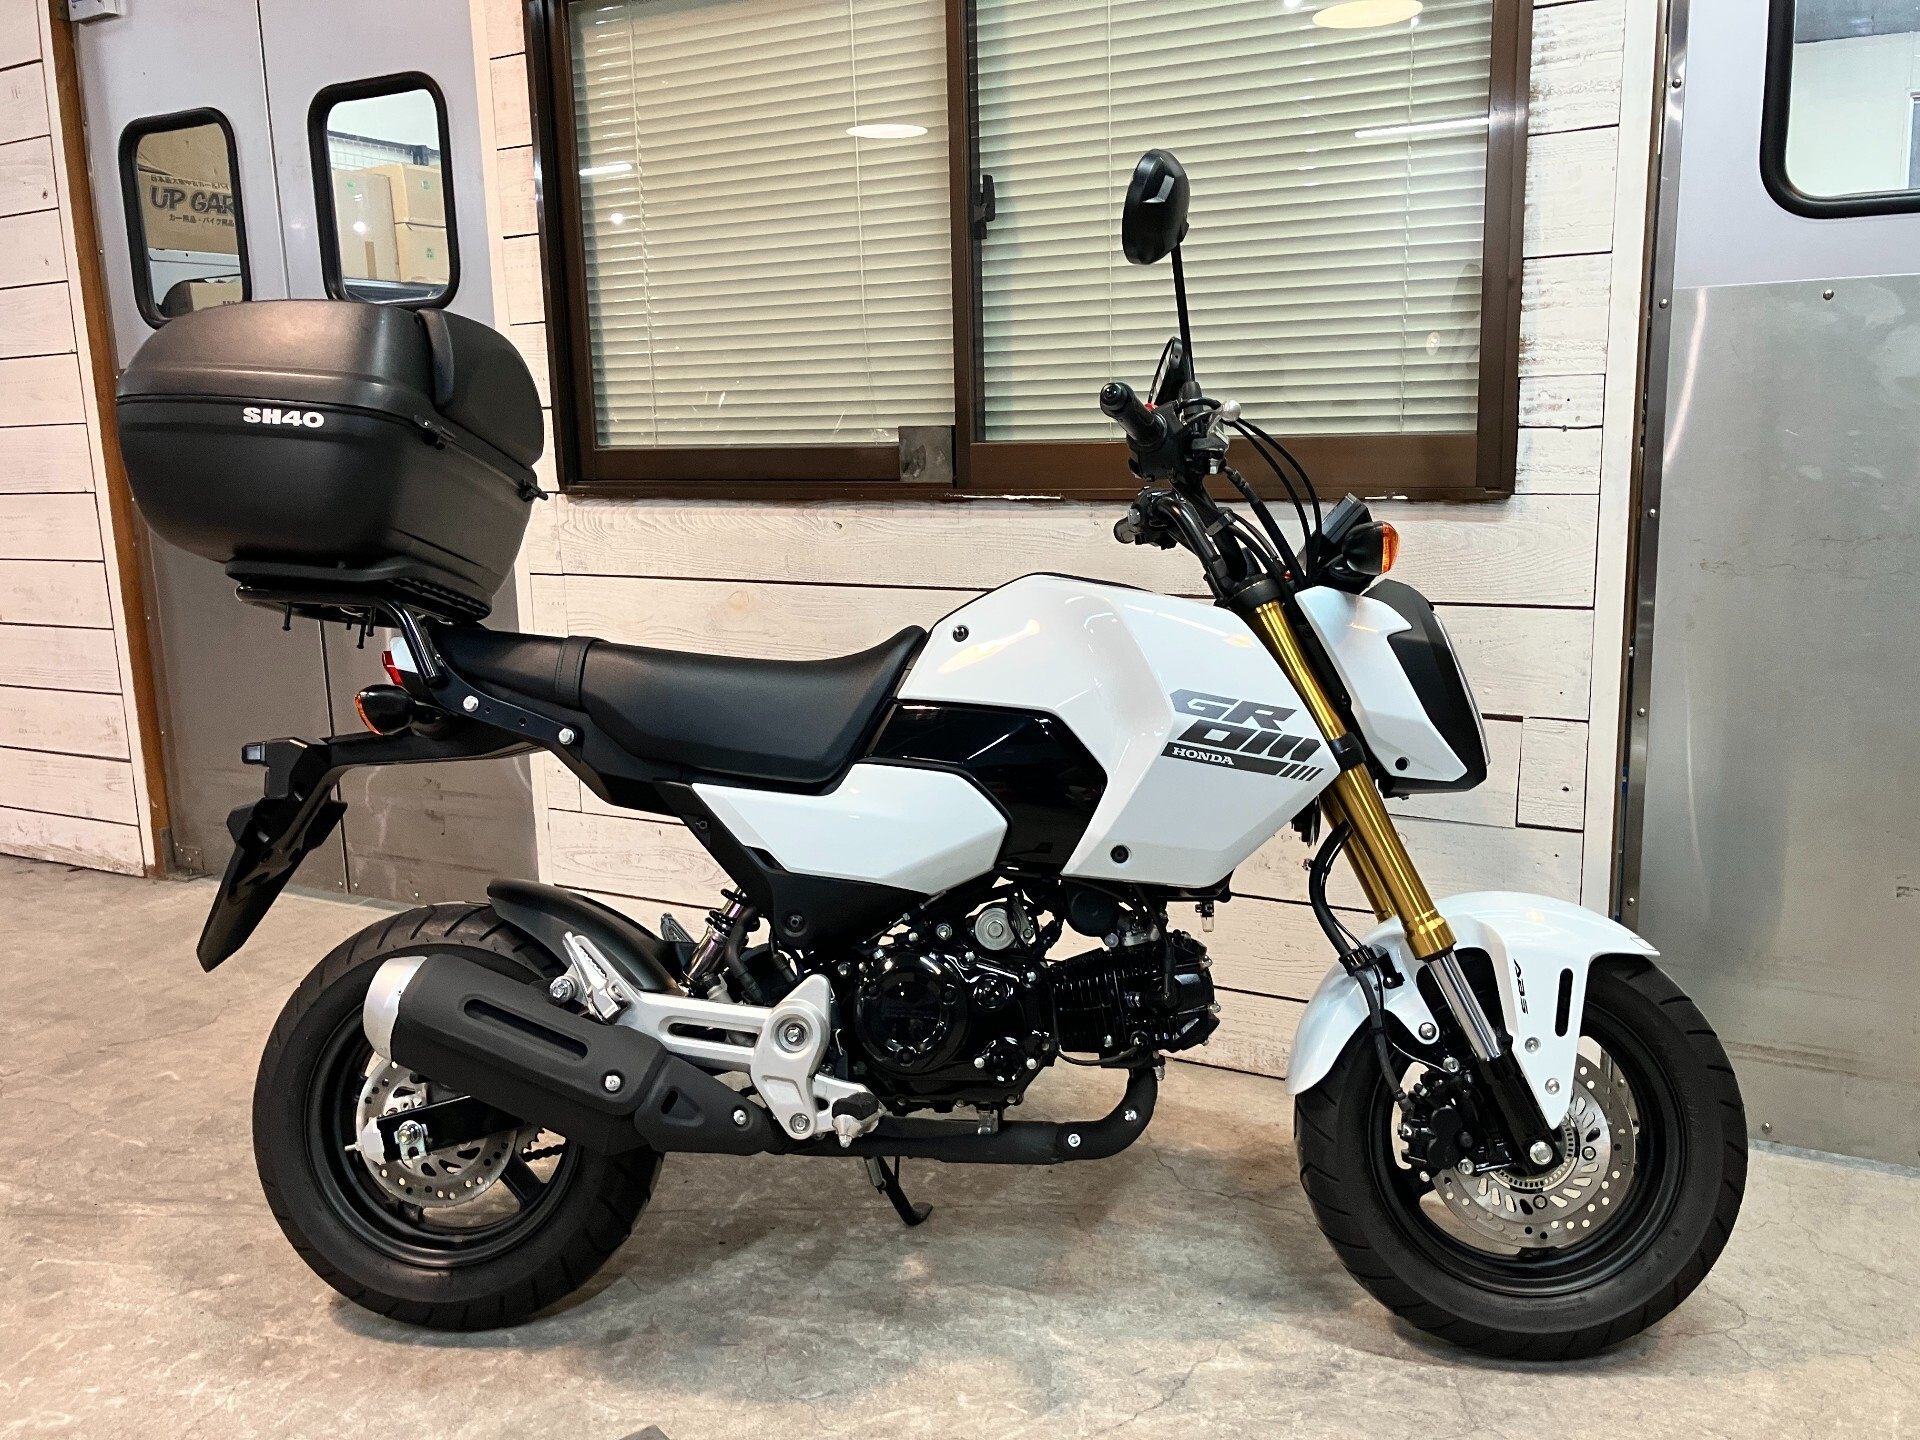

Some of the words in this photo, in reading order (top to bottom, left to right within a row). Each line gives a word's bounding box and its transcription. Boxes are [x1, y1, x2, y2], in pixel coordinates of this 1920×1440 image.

[150, 185, 187, 210] UP
[243, 407, 325, 428] SH40
[1172, 746, 1235, 766] HONDA
[1513, 957, 1529, 1015] ABS
